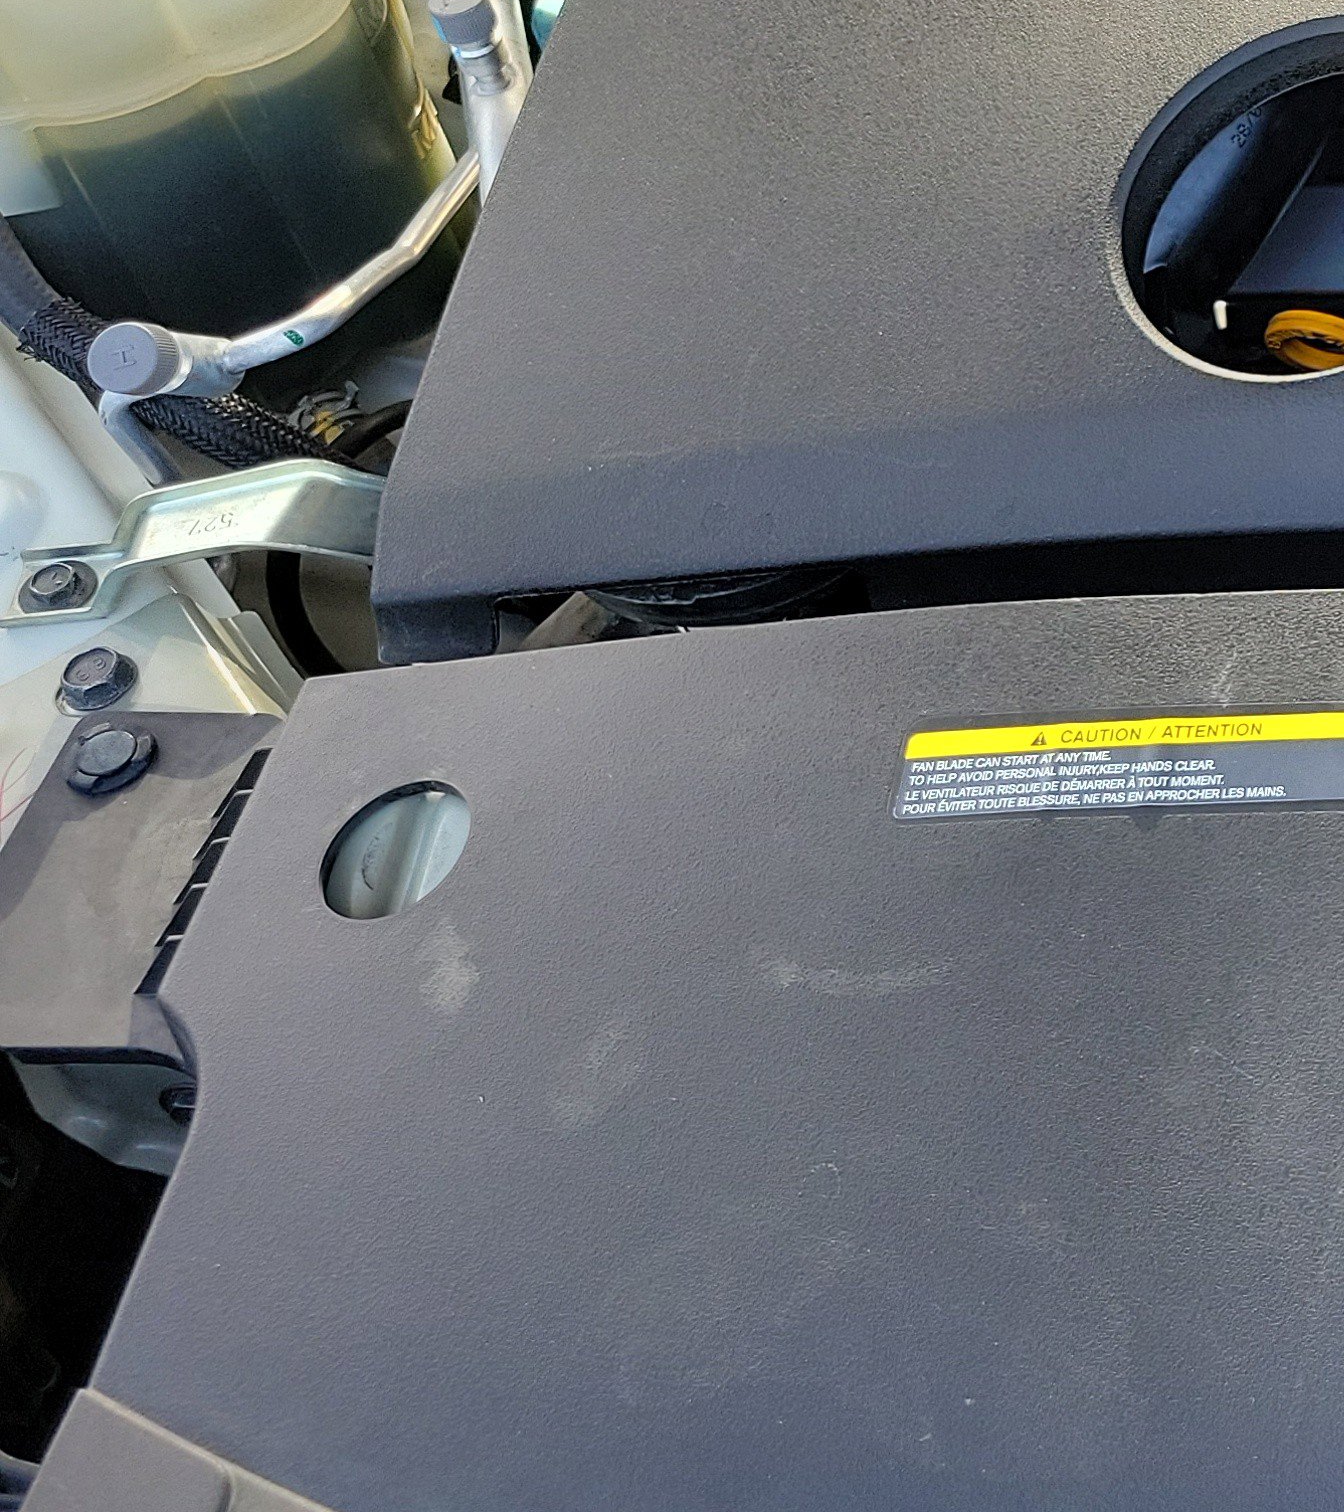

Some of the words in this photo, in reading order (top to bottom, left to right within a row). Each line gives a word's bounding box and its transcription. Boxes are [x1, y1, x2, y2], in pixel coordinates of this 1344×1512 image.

[1060, 727, 1142, 744] CAUTION
[1161, 722, 1263, 739] ATTENTION
[909, 774, 925, 786] TO
[926, 773, 957, 785] HELP
[958, 770, 993, 783] AVOID
[995, 767, 1057, 781] PERSONAL
[1131, 760, 1172, 773] HANDS
[911, 761, 935, 773] FAN
[935, 758, 974, 771] BLADE
[975, 757, 1000, 769] CAN
[1001, 754, 1037, 767] START
[1038, 753, 1056, 764] AT
[1056, 751, 1083, 763] ANY
[902, 802, 936, 815] POUR
[937, 798, 976, 812] ÉVITER
[977, 796, 1017, 810] TOUTE
[1017, 794, 1081, 807] BLESSURE,
[1083, 793, 1101, 805] NE
[1102, 791, 1126, 804] PAS
[1127, 791, 1145, 803] EN
[1145, 788, 1221, 802] APPROCHER
[1221, 787, 1245, 799] LES
[1246, 785, 1287, 798] MAINS.
[905, 790, 921, 801] LE
[922, 785, 996, 800] VENTILATEUR
[996, 781, 1043, 796] RISQUE
[1043, 780, 1060, 792] DE
[1062, 776, 1126, 791] DÉMARRER
[1126, 775, 1137, 789] À
[1138, 776, 1169, 788] TOUT
[1170, 774, 1225, 787] MOMENT.
